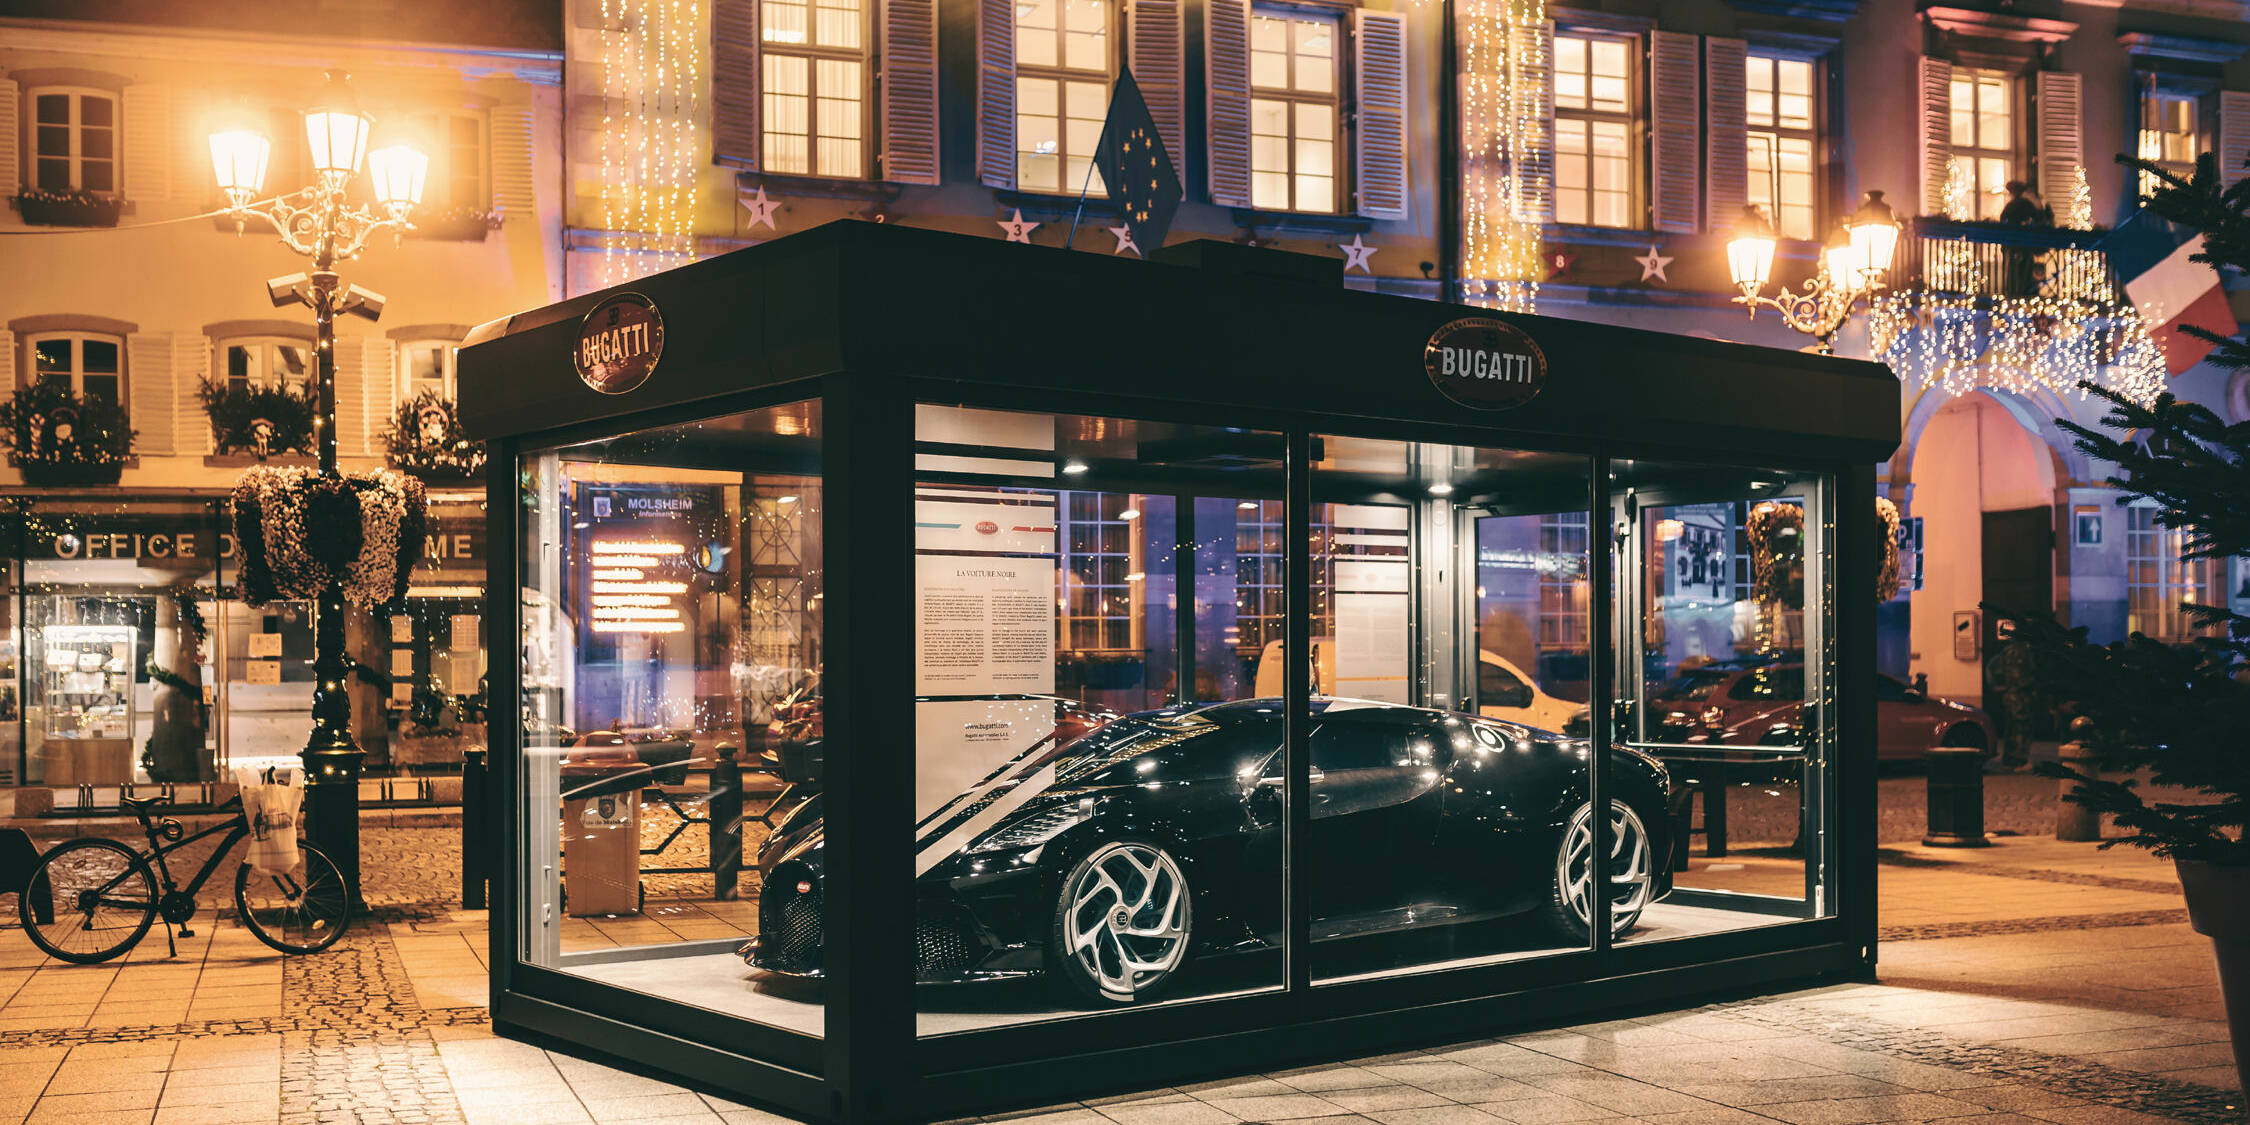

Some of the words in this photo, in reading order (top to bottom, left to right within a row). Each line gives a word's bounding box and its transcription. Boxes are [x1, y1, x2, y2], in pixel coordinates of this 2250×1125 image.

[1013, 224, 1022, 236] 3
[1354, 248, 1362, 260] 7
[582, 322, 649, 368] BUGATTI
[1441, 346, 1532, 384] BUGATTI
[628, 498, 692, 510] MOLSHEIM
[55, 533, 196, 559] OFFICE
